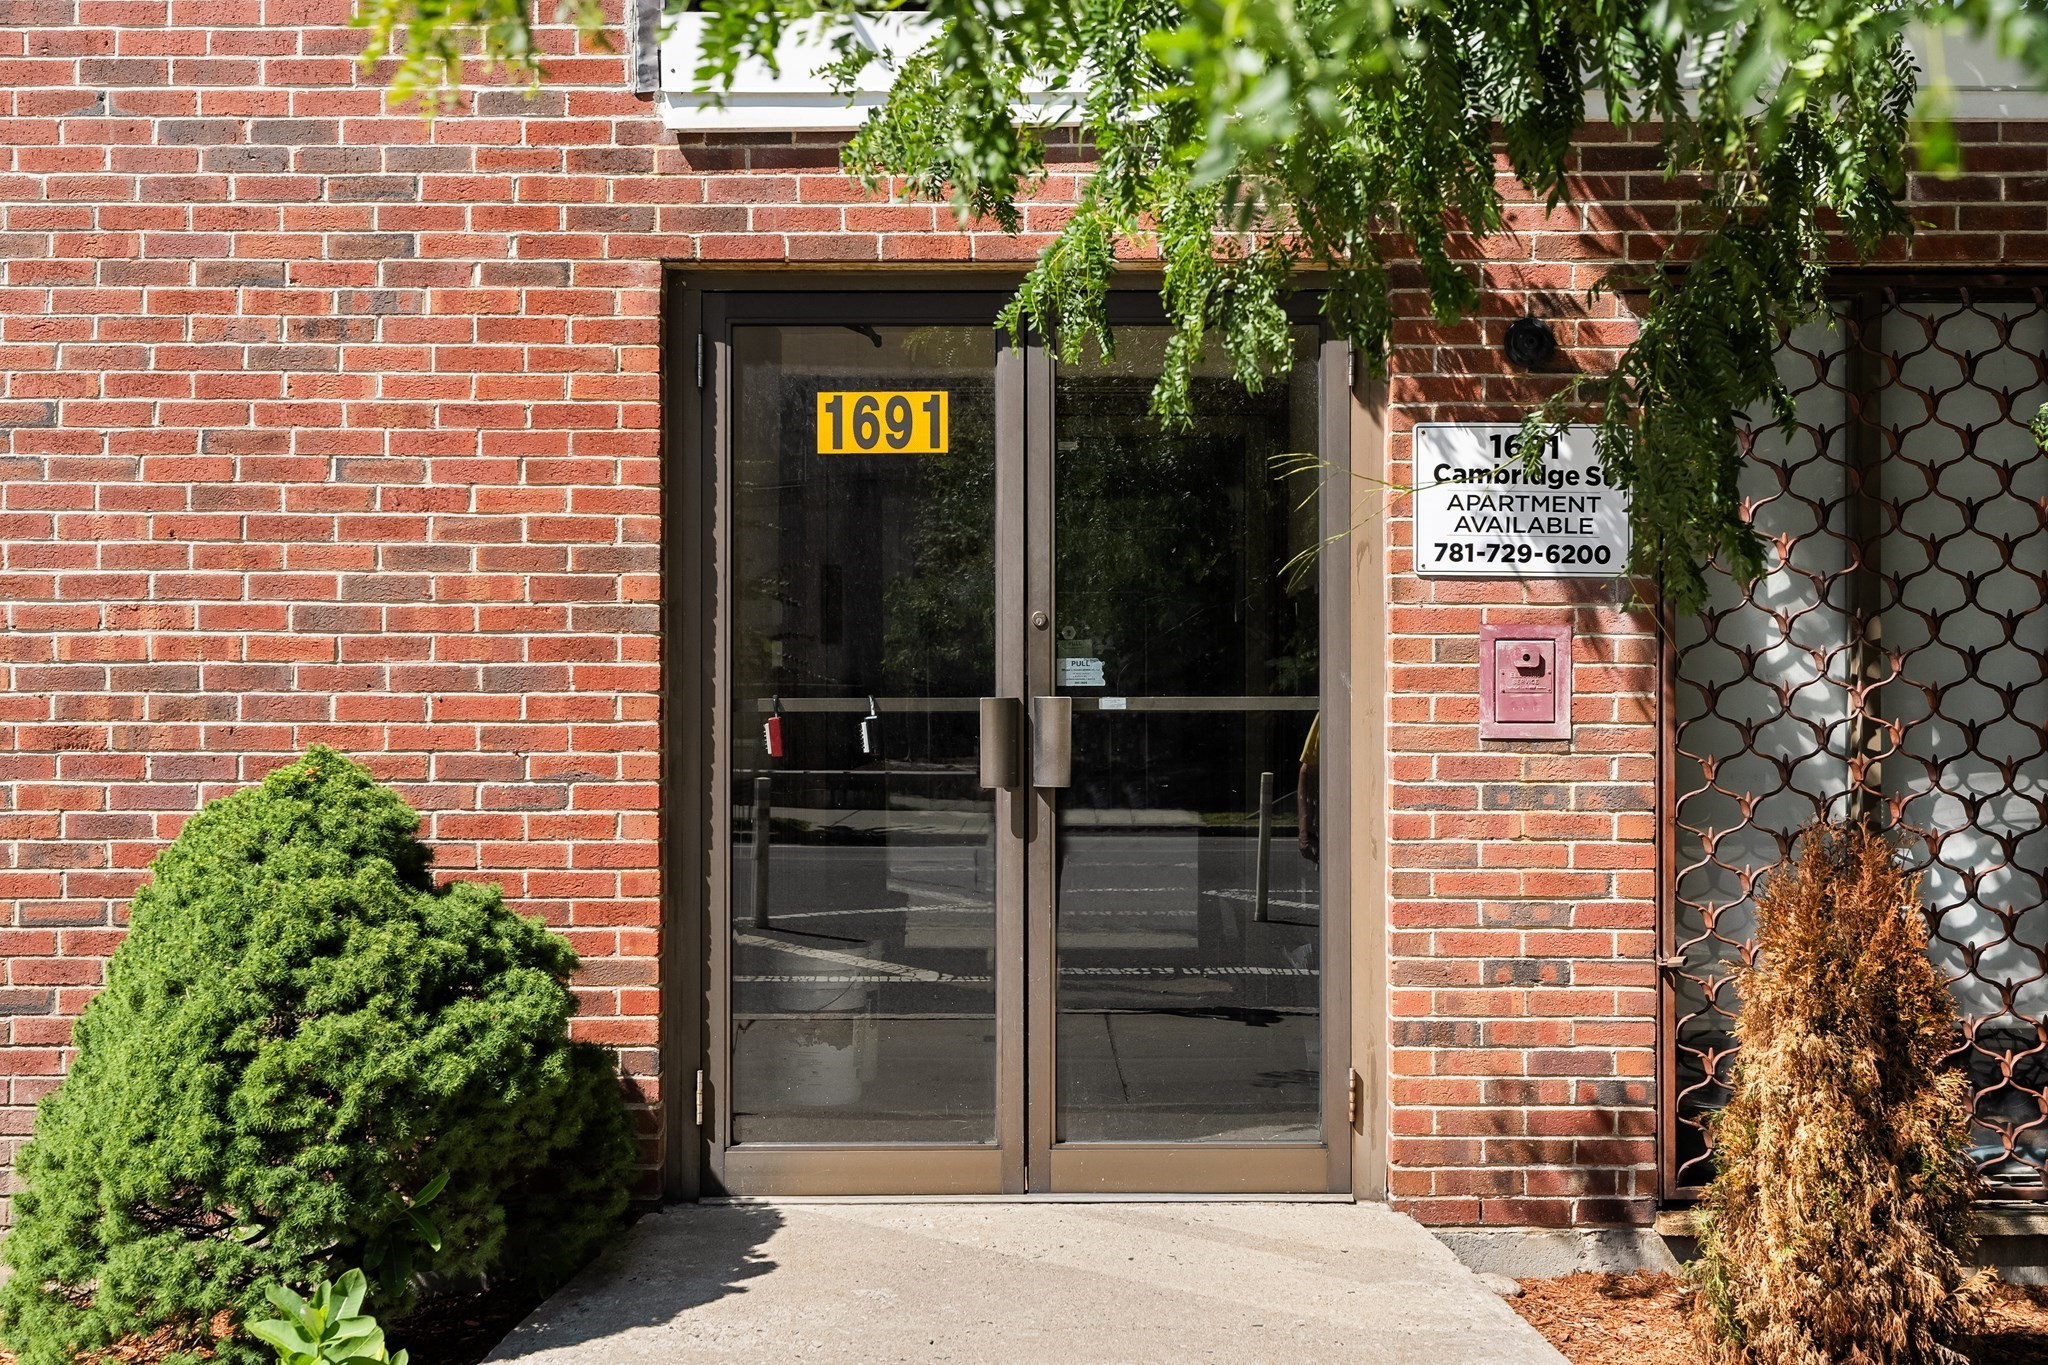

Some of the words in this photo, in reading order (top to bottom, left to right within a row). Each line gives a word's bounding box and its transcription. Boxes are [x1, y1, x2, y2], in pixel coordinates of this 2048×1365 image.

[825, 394, 941, 450] 1691
[1434, 463, 1580, 490] Cambridge
[1447, 494, 1601, 513] APARTMENT
[1454, 516, 1594, 535] AVAILABLE
[1434, 543, 1611, 564] 781-729-6200
